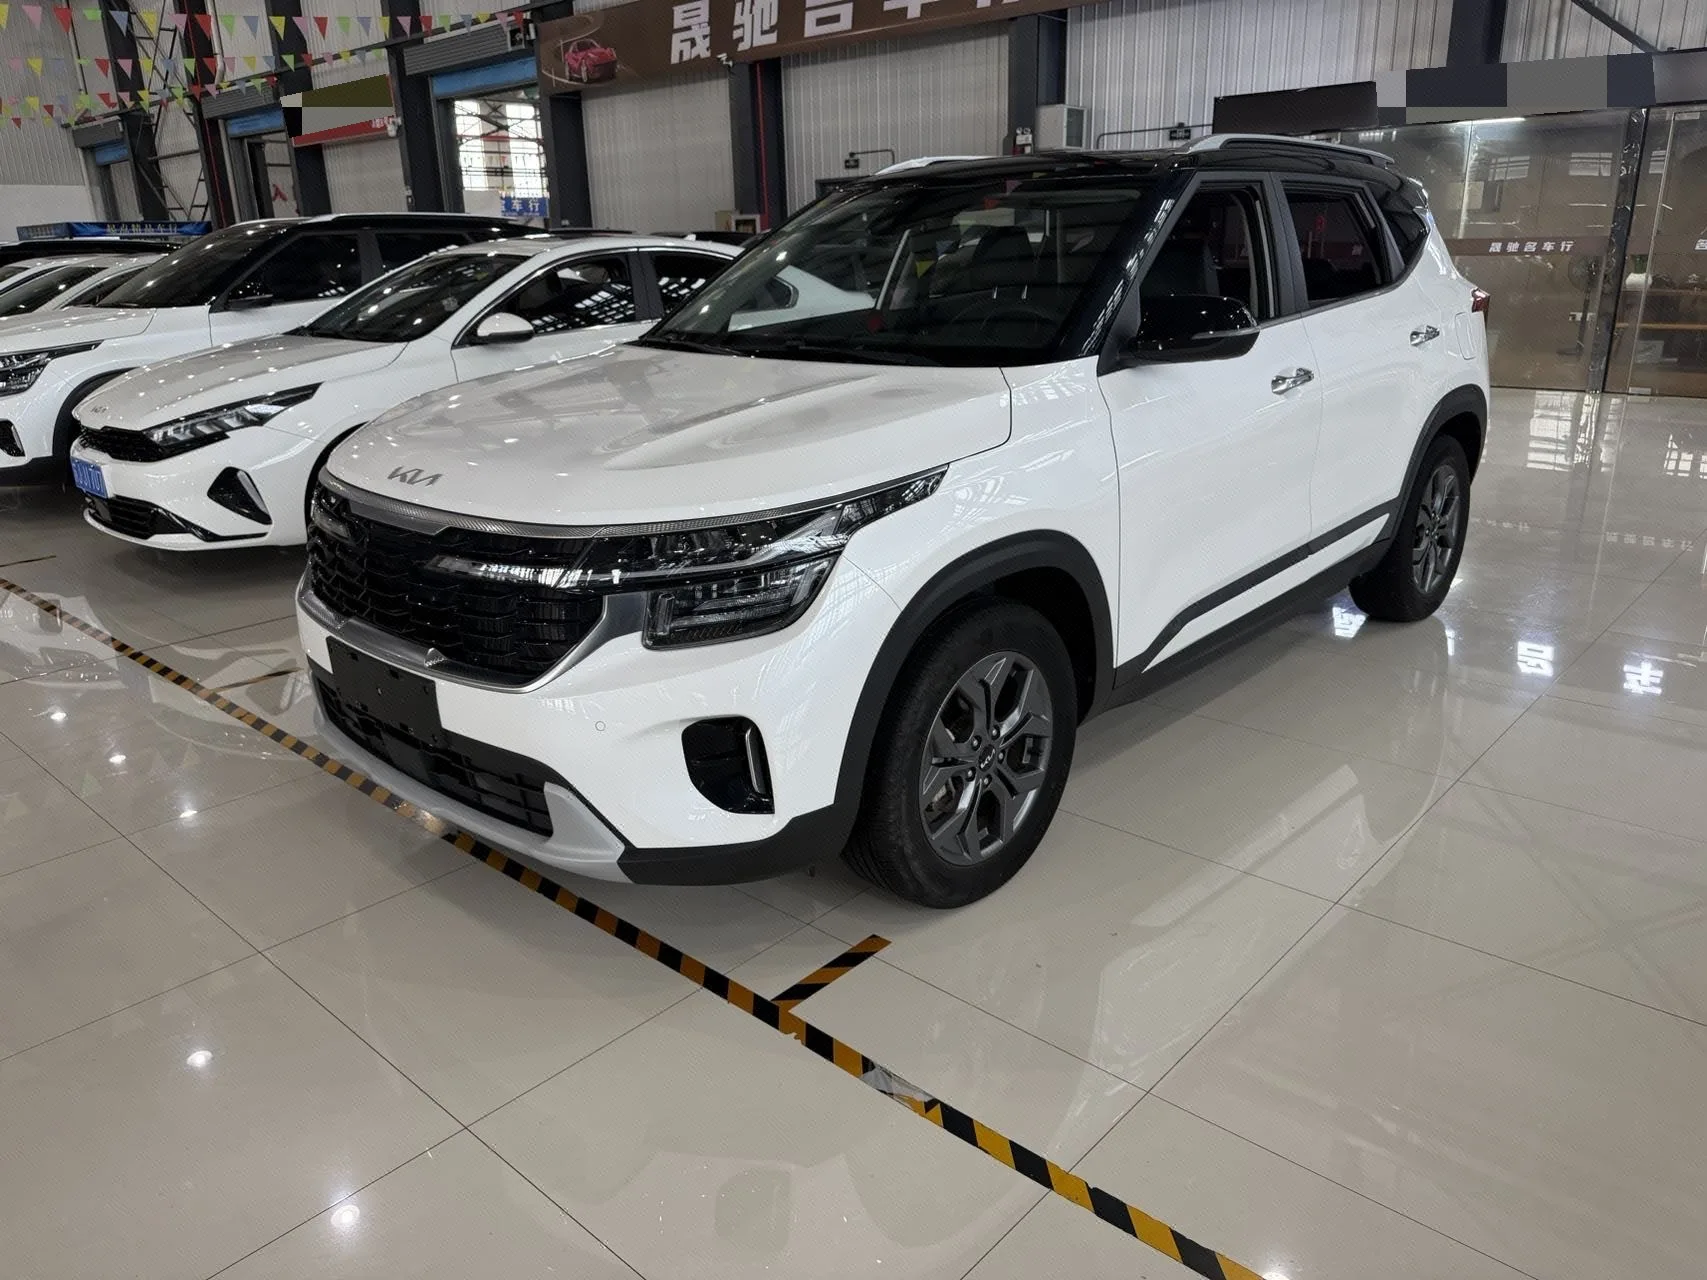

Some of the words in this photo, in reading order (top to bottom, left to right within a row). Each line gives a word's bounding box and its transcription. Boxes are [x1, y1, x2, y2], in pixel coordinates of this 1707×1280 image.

[1489, 240, 1576, 253] 晟驰名车行
[387, 465, 443, 487] KIA
